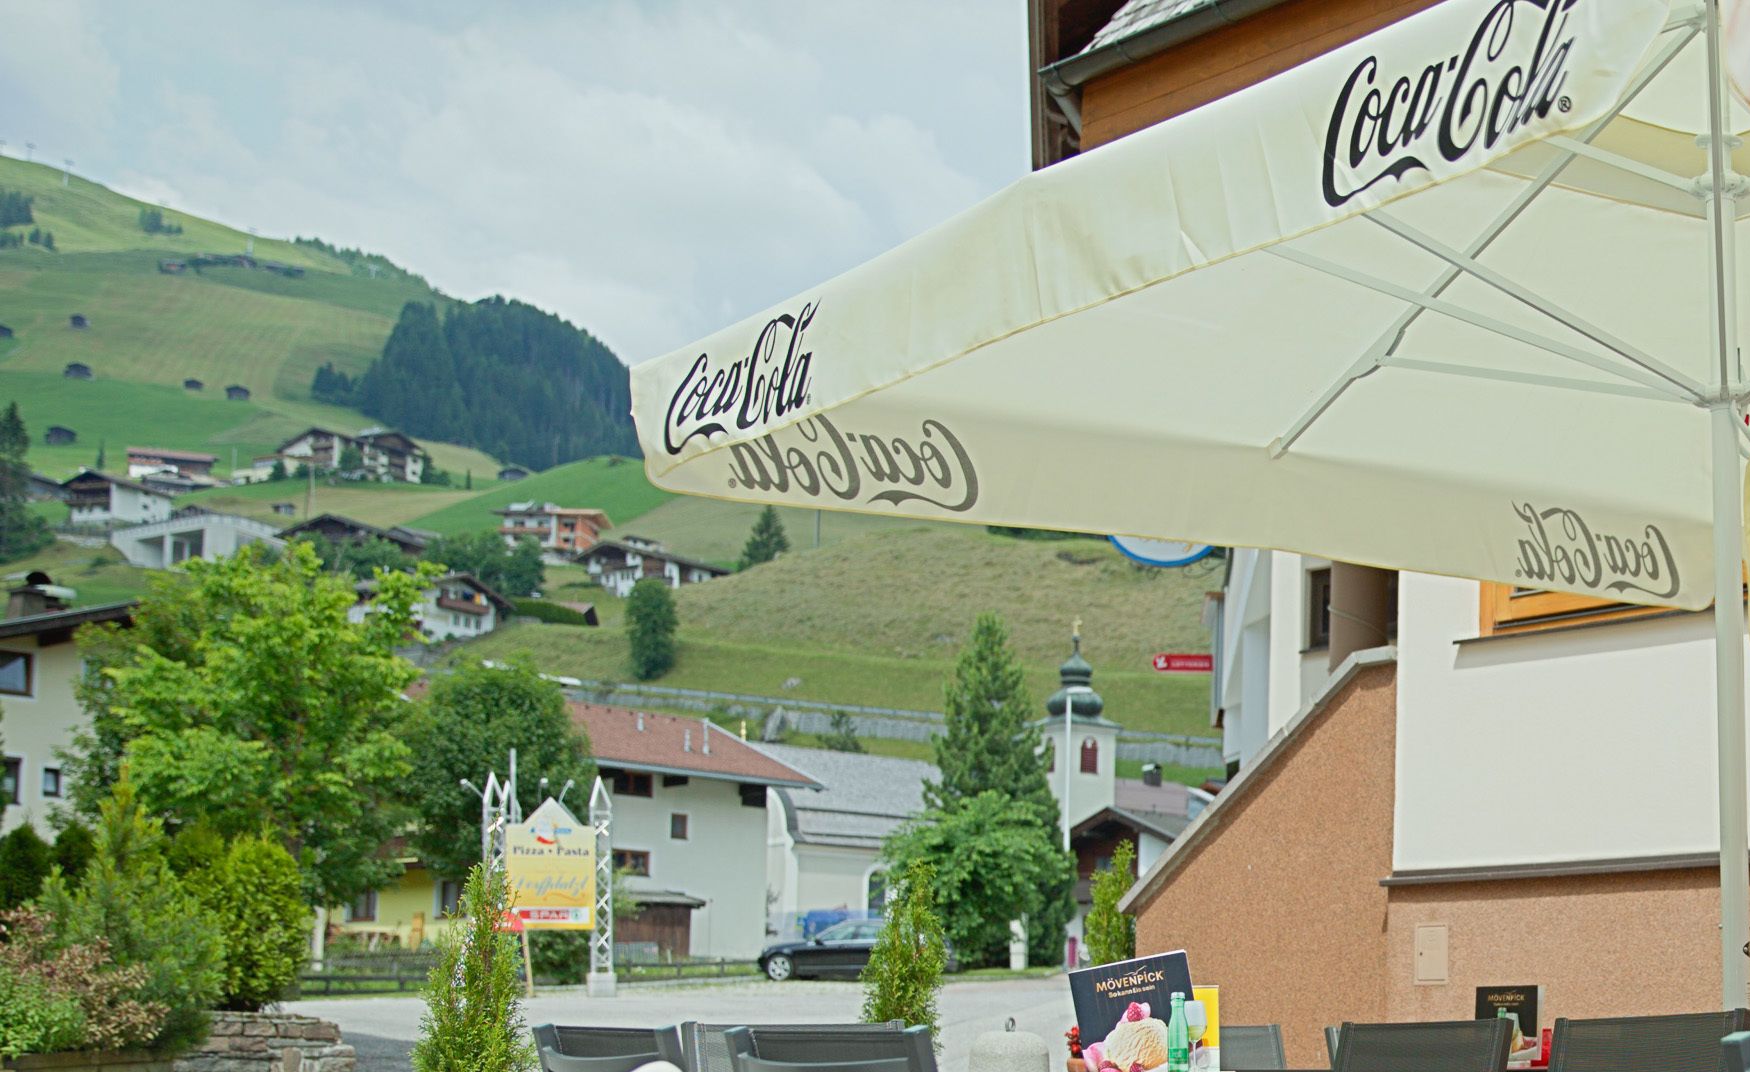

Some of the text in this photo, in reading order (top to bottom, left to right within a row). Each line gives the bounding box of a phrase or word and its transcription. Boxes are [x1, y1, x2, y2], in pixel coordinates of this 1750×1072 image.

[1322, 0, 1577, 207] Coca-Cola
[664, 296, 822, 456] Coca-Cola
[513, 845, 590, 856] Pizza Pasta
